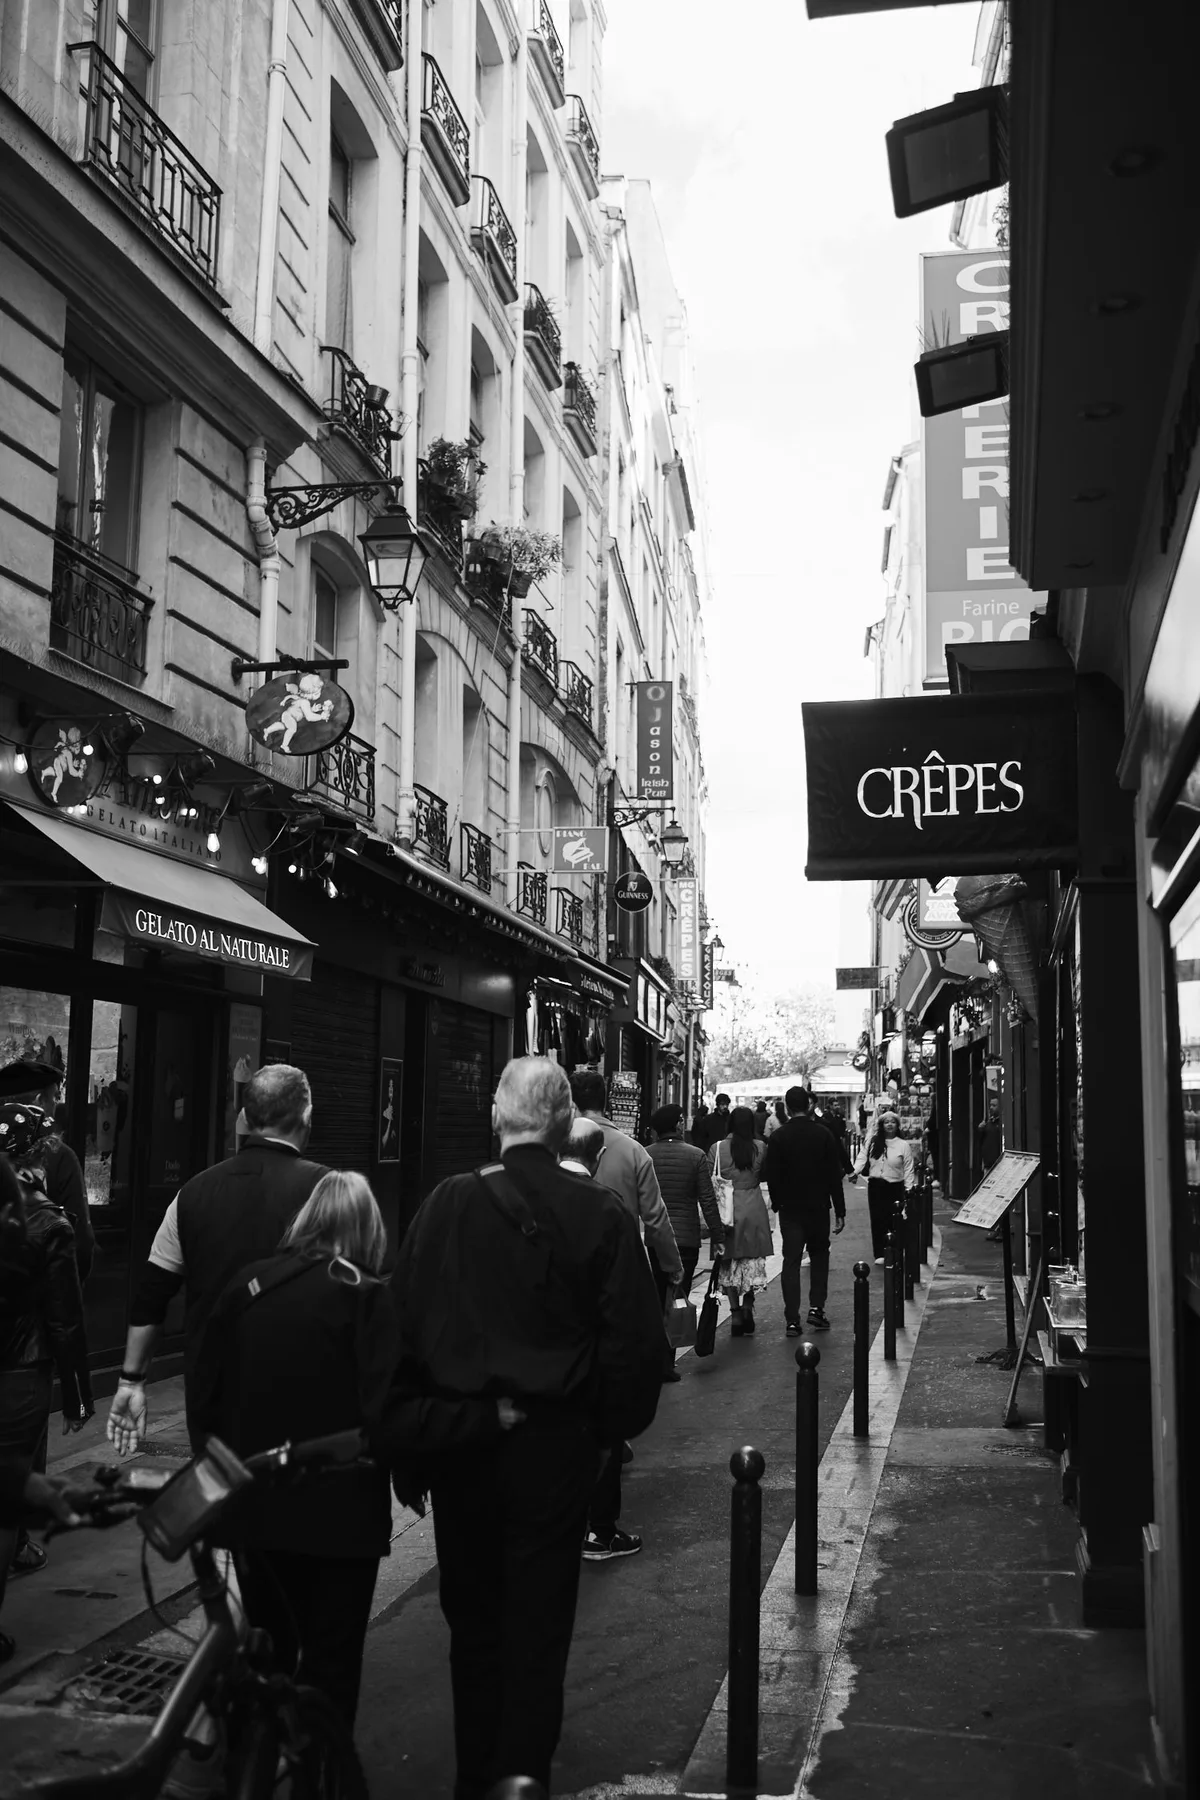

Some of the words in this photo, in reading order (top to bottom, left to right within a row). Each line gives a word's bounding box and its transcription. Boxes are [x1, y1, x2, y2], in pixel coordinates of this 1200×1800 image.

[962, 599, 1020, 616] Farine
[641, 777, 670, 787] Irish
[644, 788, 667, 798] Pub
[857, 749, 1024, 830] CRÊPES
[86, 804, 147, 836] GELATO
[556, 830, 587, 838] PIANO
[678, 881, 695, 889] MG
[617, 889, 650, 900] GUINNESS
[135, 908, 197, 946] GELATO
[199, 928, 220, 953] AL
[220, 933, 290, 969] NATURALE
[679, 888, 694, 977] CRÊPES
